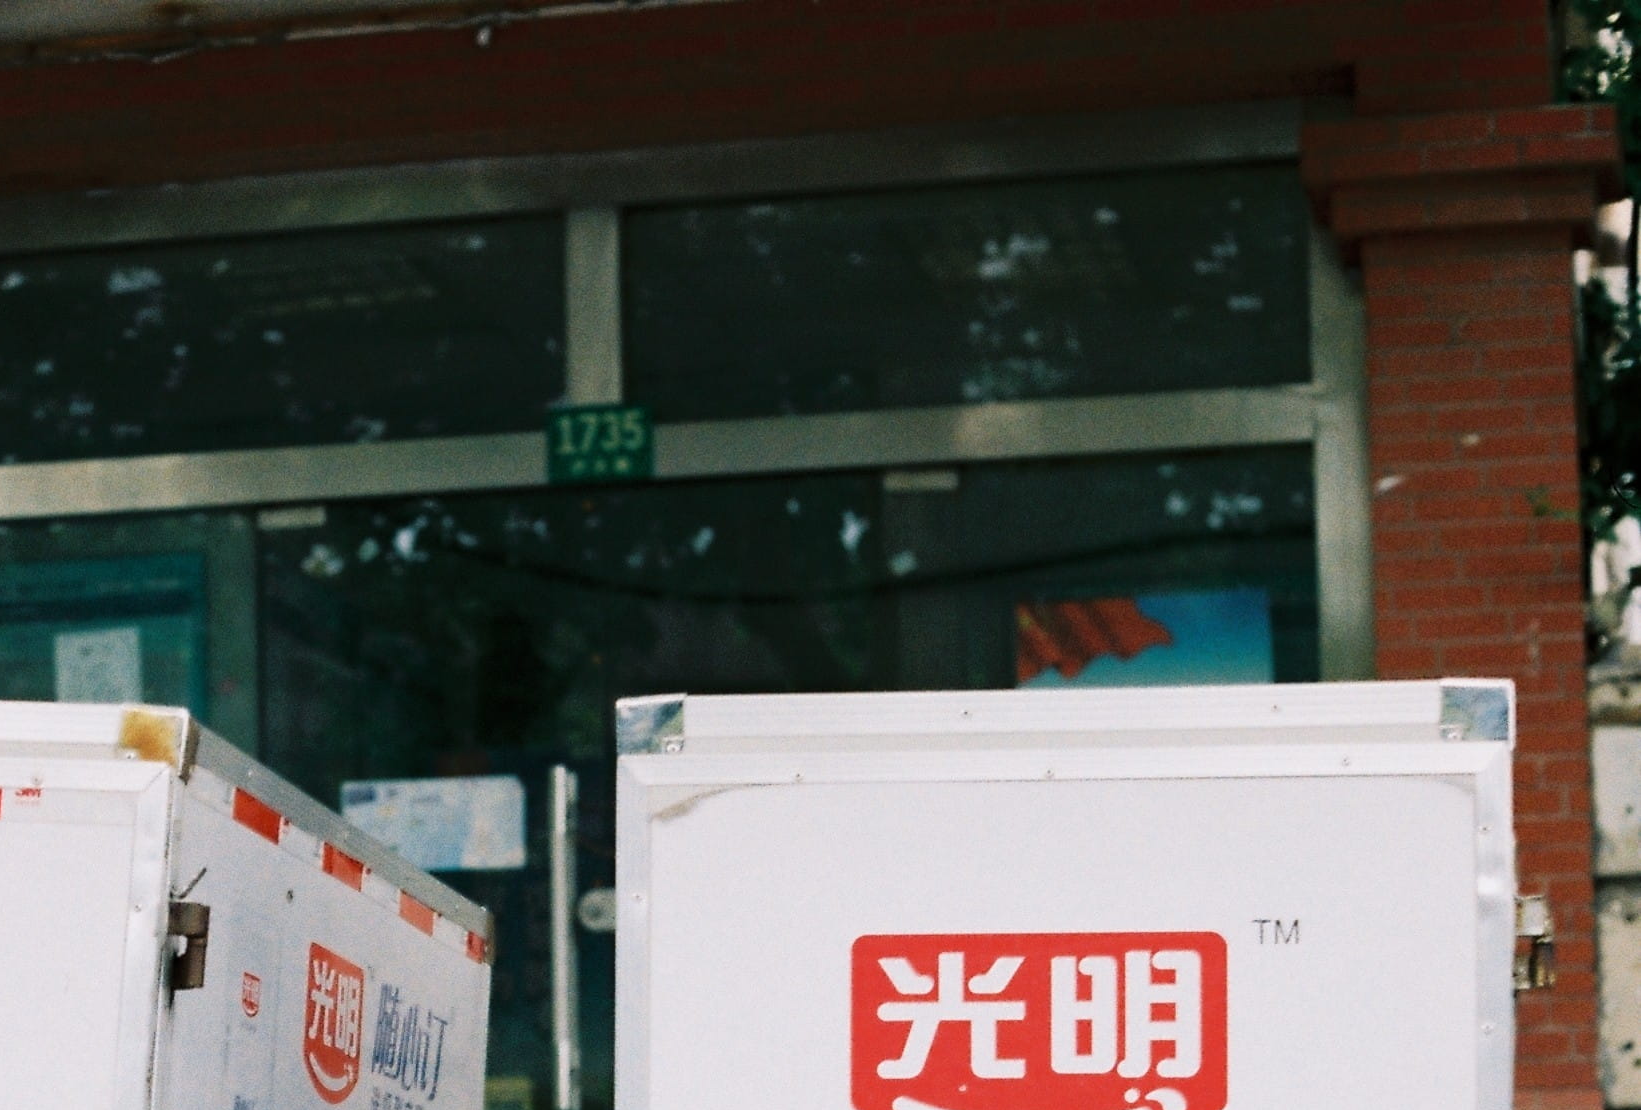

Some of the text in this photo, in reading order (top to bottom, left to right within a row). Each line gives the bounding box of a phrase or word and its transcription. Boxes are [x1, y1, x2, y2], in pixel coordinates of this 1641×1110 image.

[557, 409, 644, 455] 1735
[1252, 919, 1300, 945] TM
[308, 960, 362, 1058] 光明
[371, 983, 448, 1101] 随心订
[877, 950, 1201, 1079] 光明
